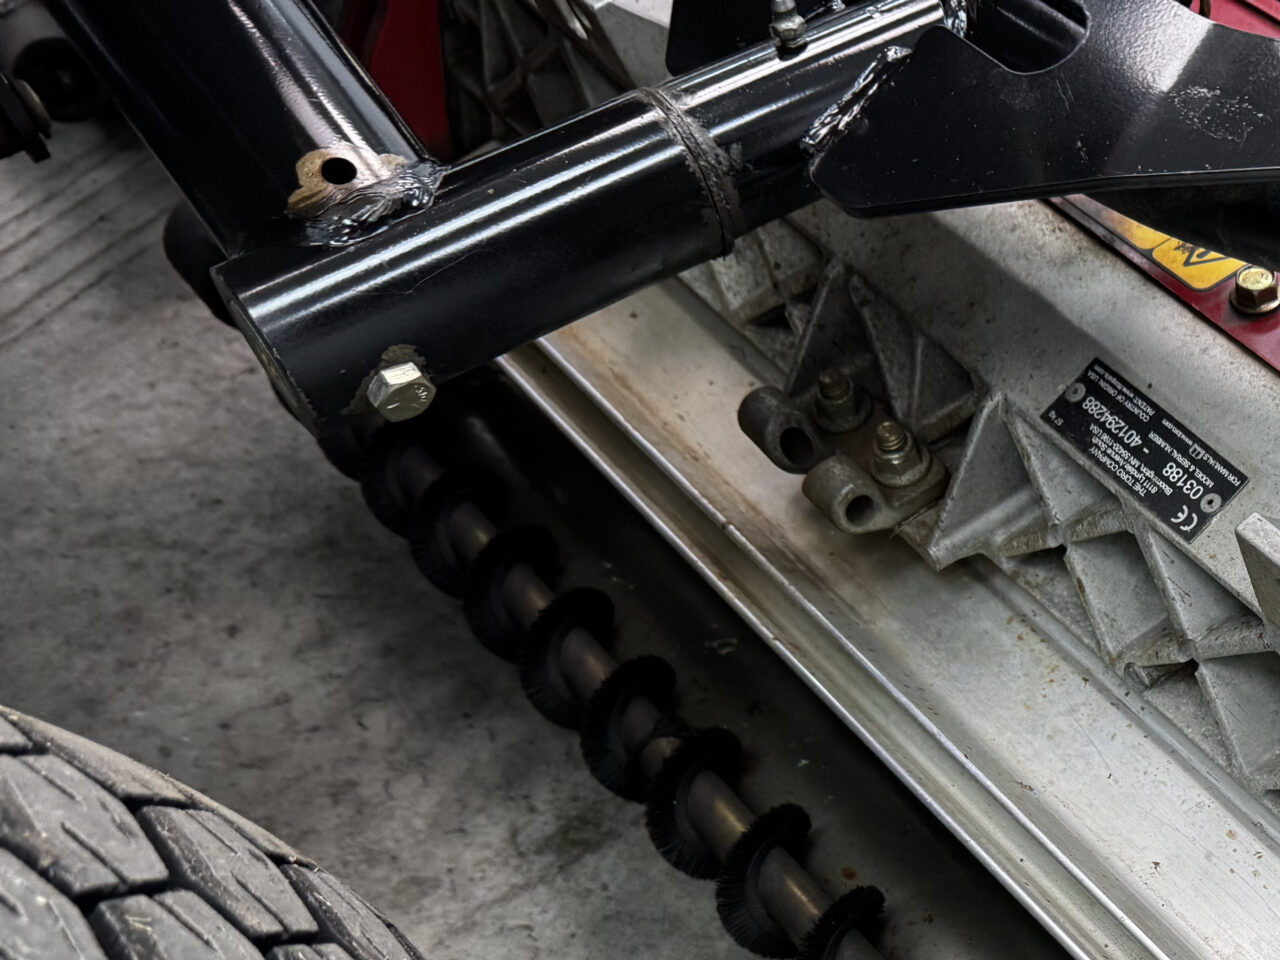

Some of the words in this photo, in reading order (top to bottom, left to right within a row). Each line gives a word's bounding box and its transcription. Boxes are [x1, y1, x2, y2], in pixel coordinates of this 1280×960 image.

[1085, 369, 1100, 382] USA
[1115, 393, 1126, 403] OF
[1122, 398, 1150, 422] COUNTRY
[1080, 394, 1145, 450] 401294288
[1087, 422, 1103, 436] USA
[1089, 434, 1108, 451] South
[1099, 431, 1131, 460] 55420-1196
[1146, 430, 1173, 453] NUMBER
[1088, 444, 1119, 472] COMPANY
[1104, 447, 1127, 467] Avenue
[1127, 455, 1141, 468] MN
[1169, 449, 1191, 468] SERIAL
[1201, 452, 1230, 477] MANUALS
[1115, 467, 1136, 486] TORO
[1122, 461, 1146, 483] Lyndale
[1187, 464, 1196, 472] &
[1191, 467, 1215, 488] MODEL
[1132, 481, 1148, 496] THE
[1142, 479, 1158, 494] 8111
[1159, 460, 1206, 501] 03188
[1226, 473, 1241, 486] FOR
